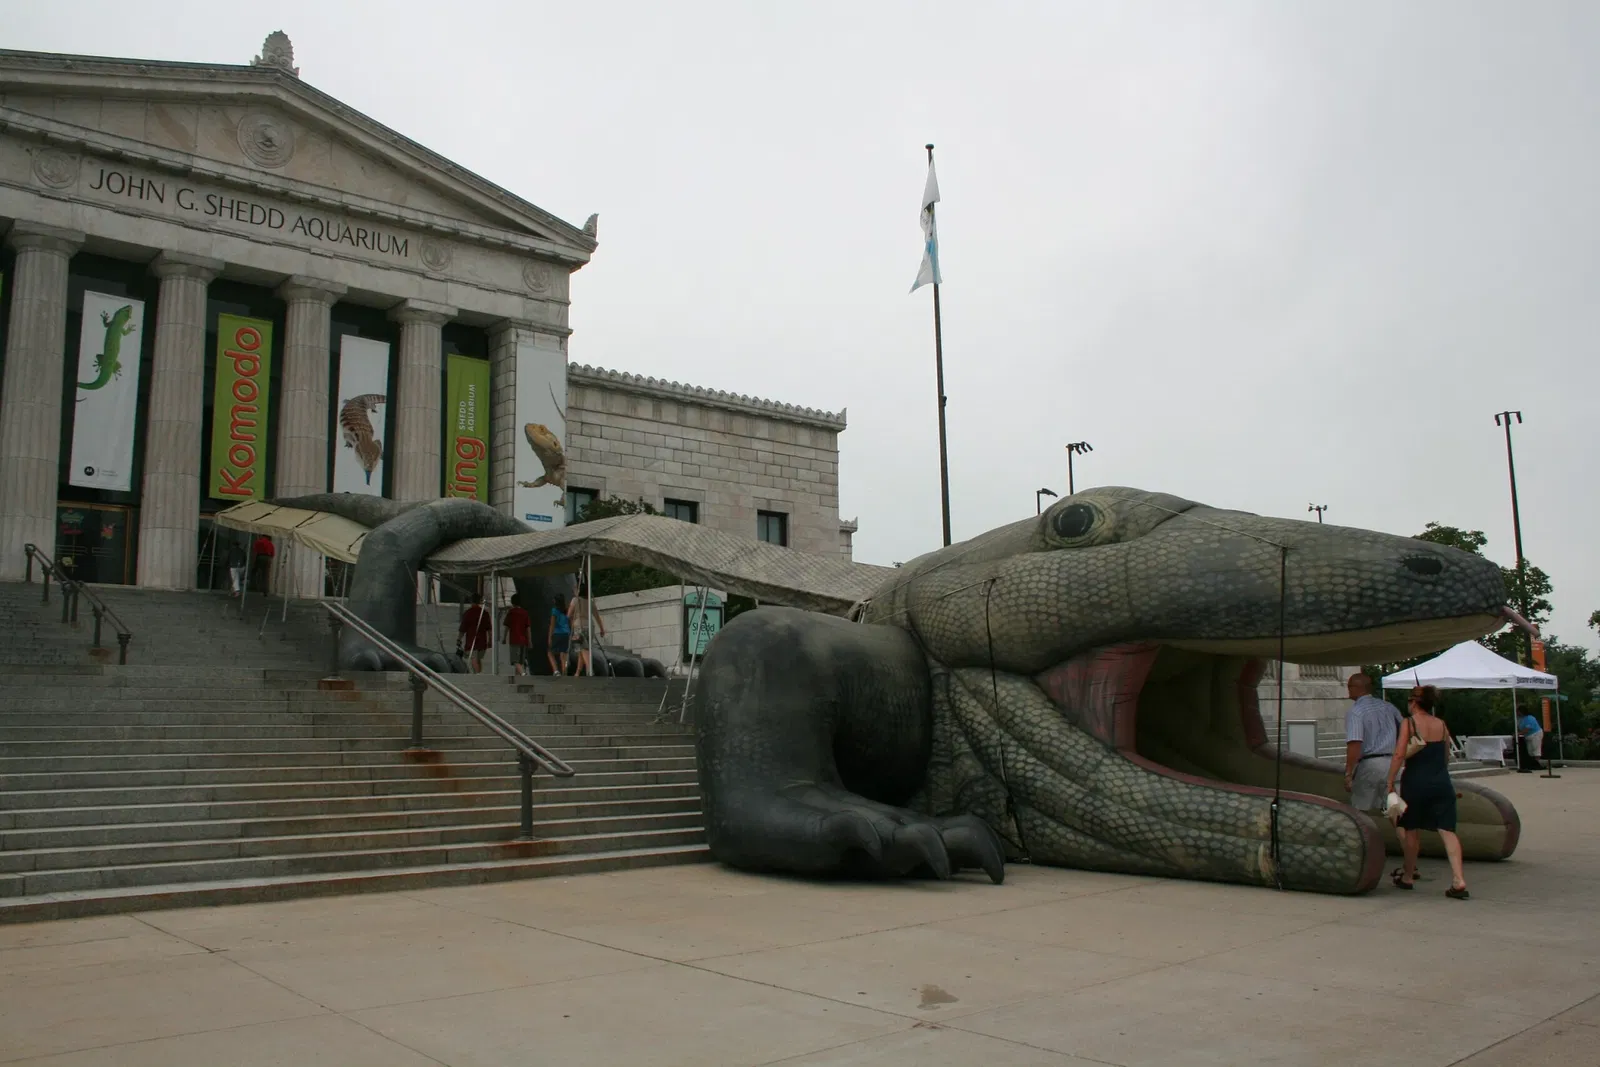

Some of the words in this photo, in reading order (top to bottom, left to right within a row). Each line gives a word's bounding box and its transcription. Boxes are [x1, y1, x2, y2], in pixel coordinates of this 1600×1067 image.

[89, 168, 165, 204] JOHN
[176, 188, 198, 211] G.
[204, 194, 285, 229] SHEDD
[290, 215, 409, 258] AQUARIUM
[218, 326, 261, 496] Komodo
[459, 400, 467, 431] SHEDD
[468, 384, 476, 432] AQUARIUM
[447, 436, 486, 501] ing
